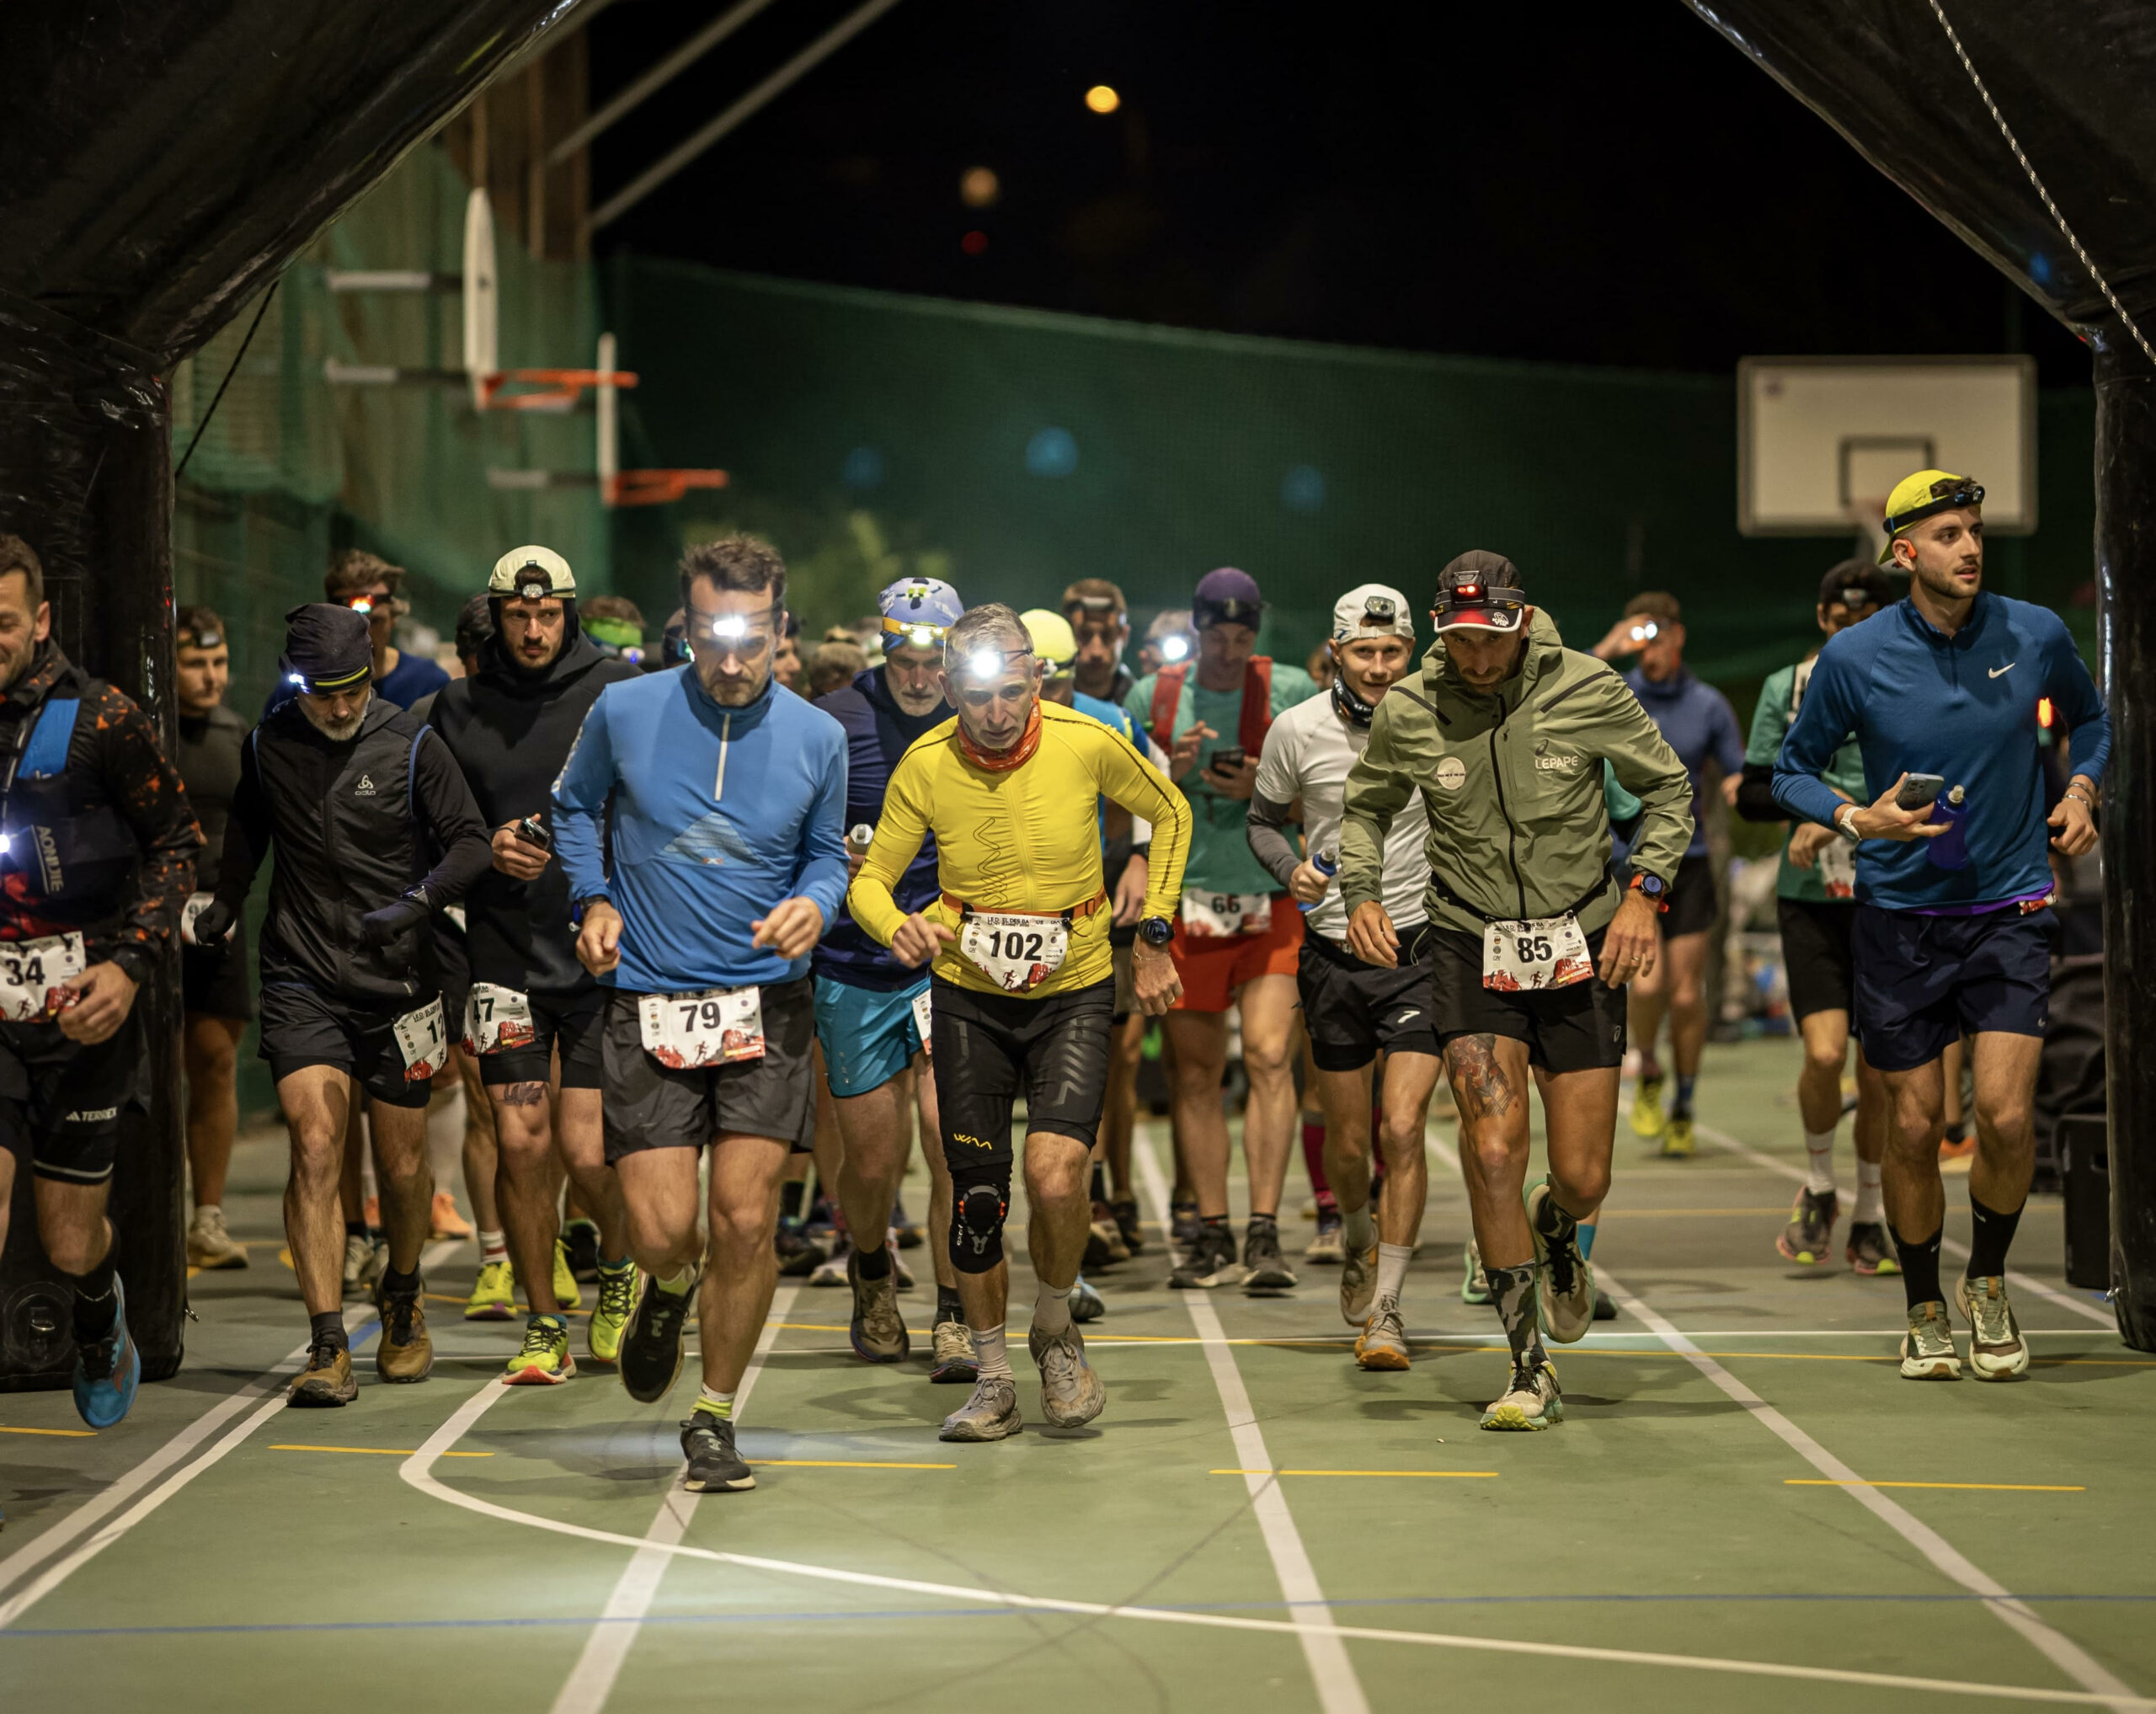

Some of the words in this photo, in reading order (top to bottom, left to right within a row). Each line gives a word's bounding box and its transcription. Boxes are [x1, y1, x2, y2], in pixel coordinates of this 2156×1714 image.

[1534, 756, 1578, 770] LEPAPE
[990, 931, 1043, 961] 102
[1518, 936, 1552, 963] 85
[5, 955, 46, 986] 34
[679, 1001, 722, 1033] 79
